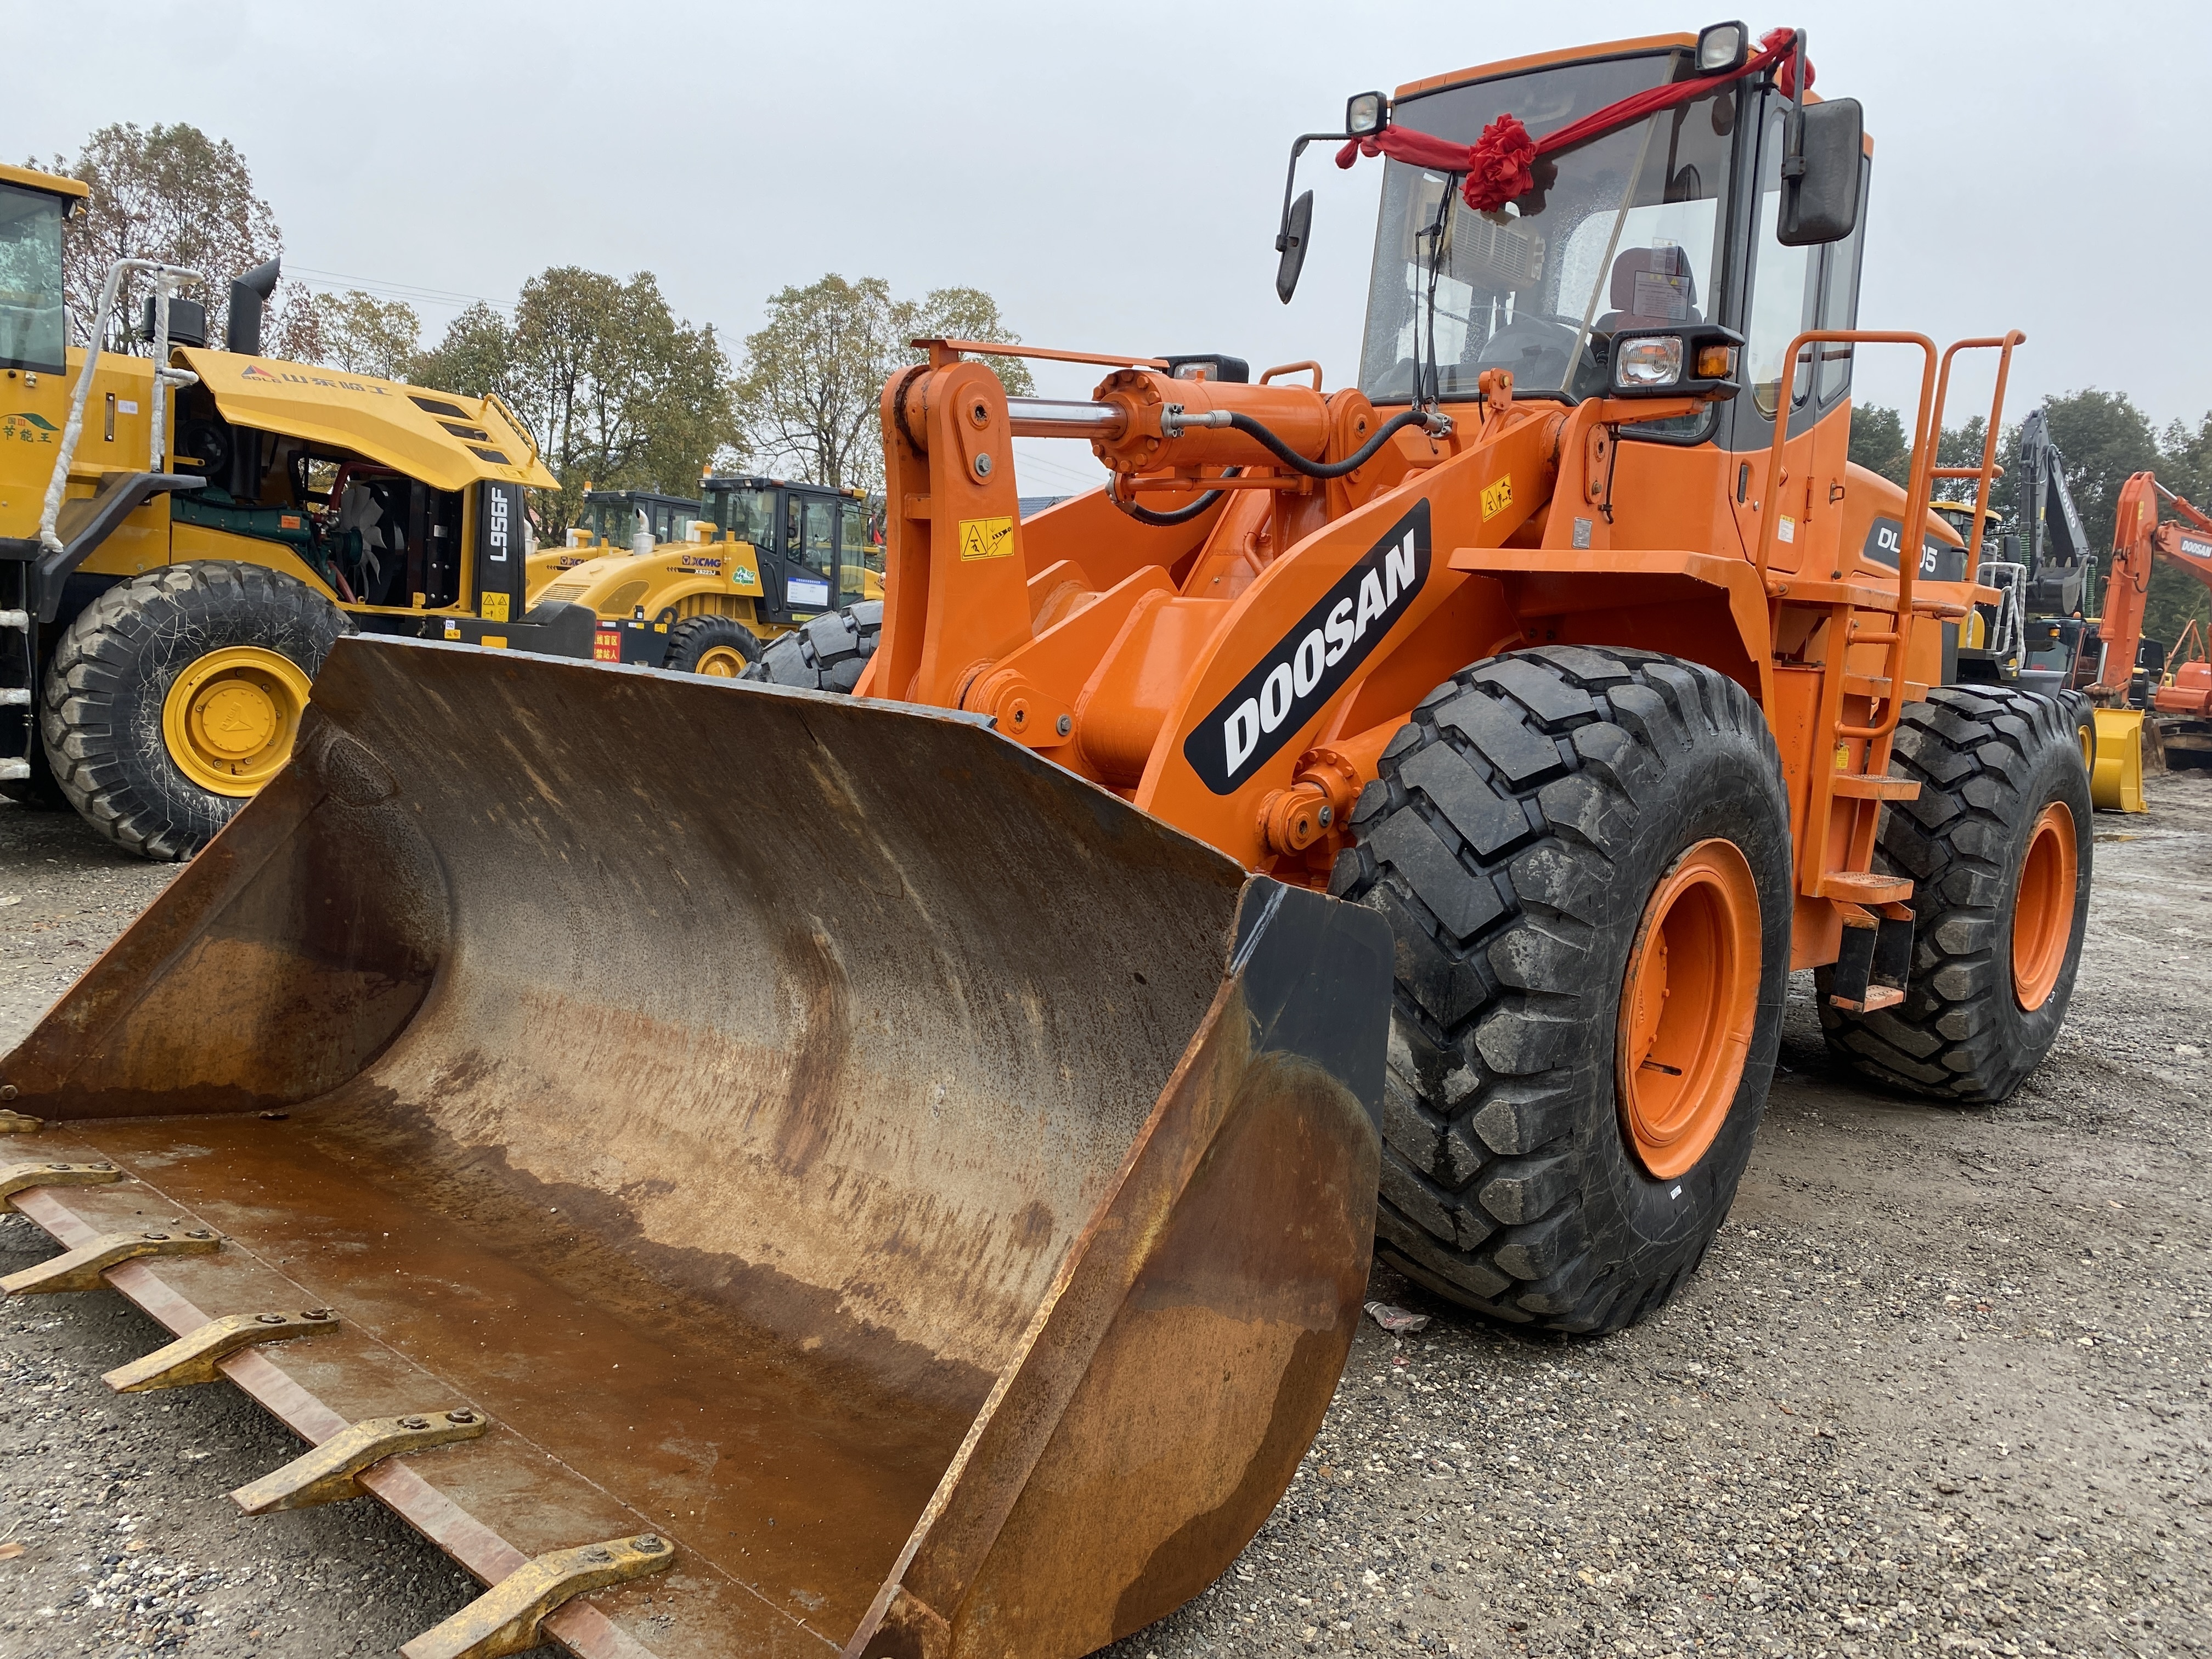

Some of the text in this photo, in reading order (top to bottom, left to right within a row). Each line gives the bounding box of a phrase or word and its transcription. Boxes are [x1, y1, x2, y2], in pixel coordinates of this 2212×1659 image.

[280, 373, 393, 396] 山东临工
[2, 425, 52, 443] 节能王
[2060, 479, 2076, 528] VOLVO
[490, 487, 507, 561] L956F
[1877, 527, 1938, 573] DL5
[2181, 540, 2212, 557] DOOSAN
[568, 557, 589, 566] XC
[691, 557, 721, 567] XCMG
[594, 634, 618, 646] 线盲区
[594, 648, 617, 660] 禁站人
[1224, 528, 1415, 778] DOOSAN
